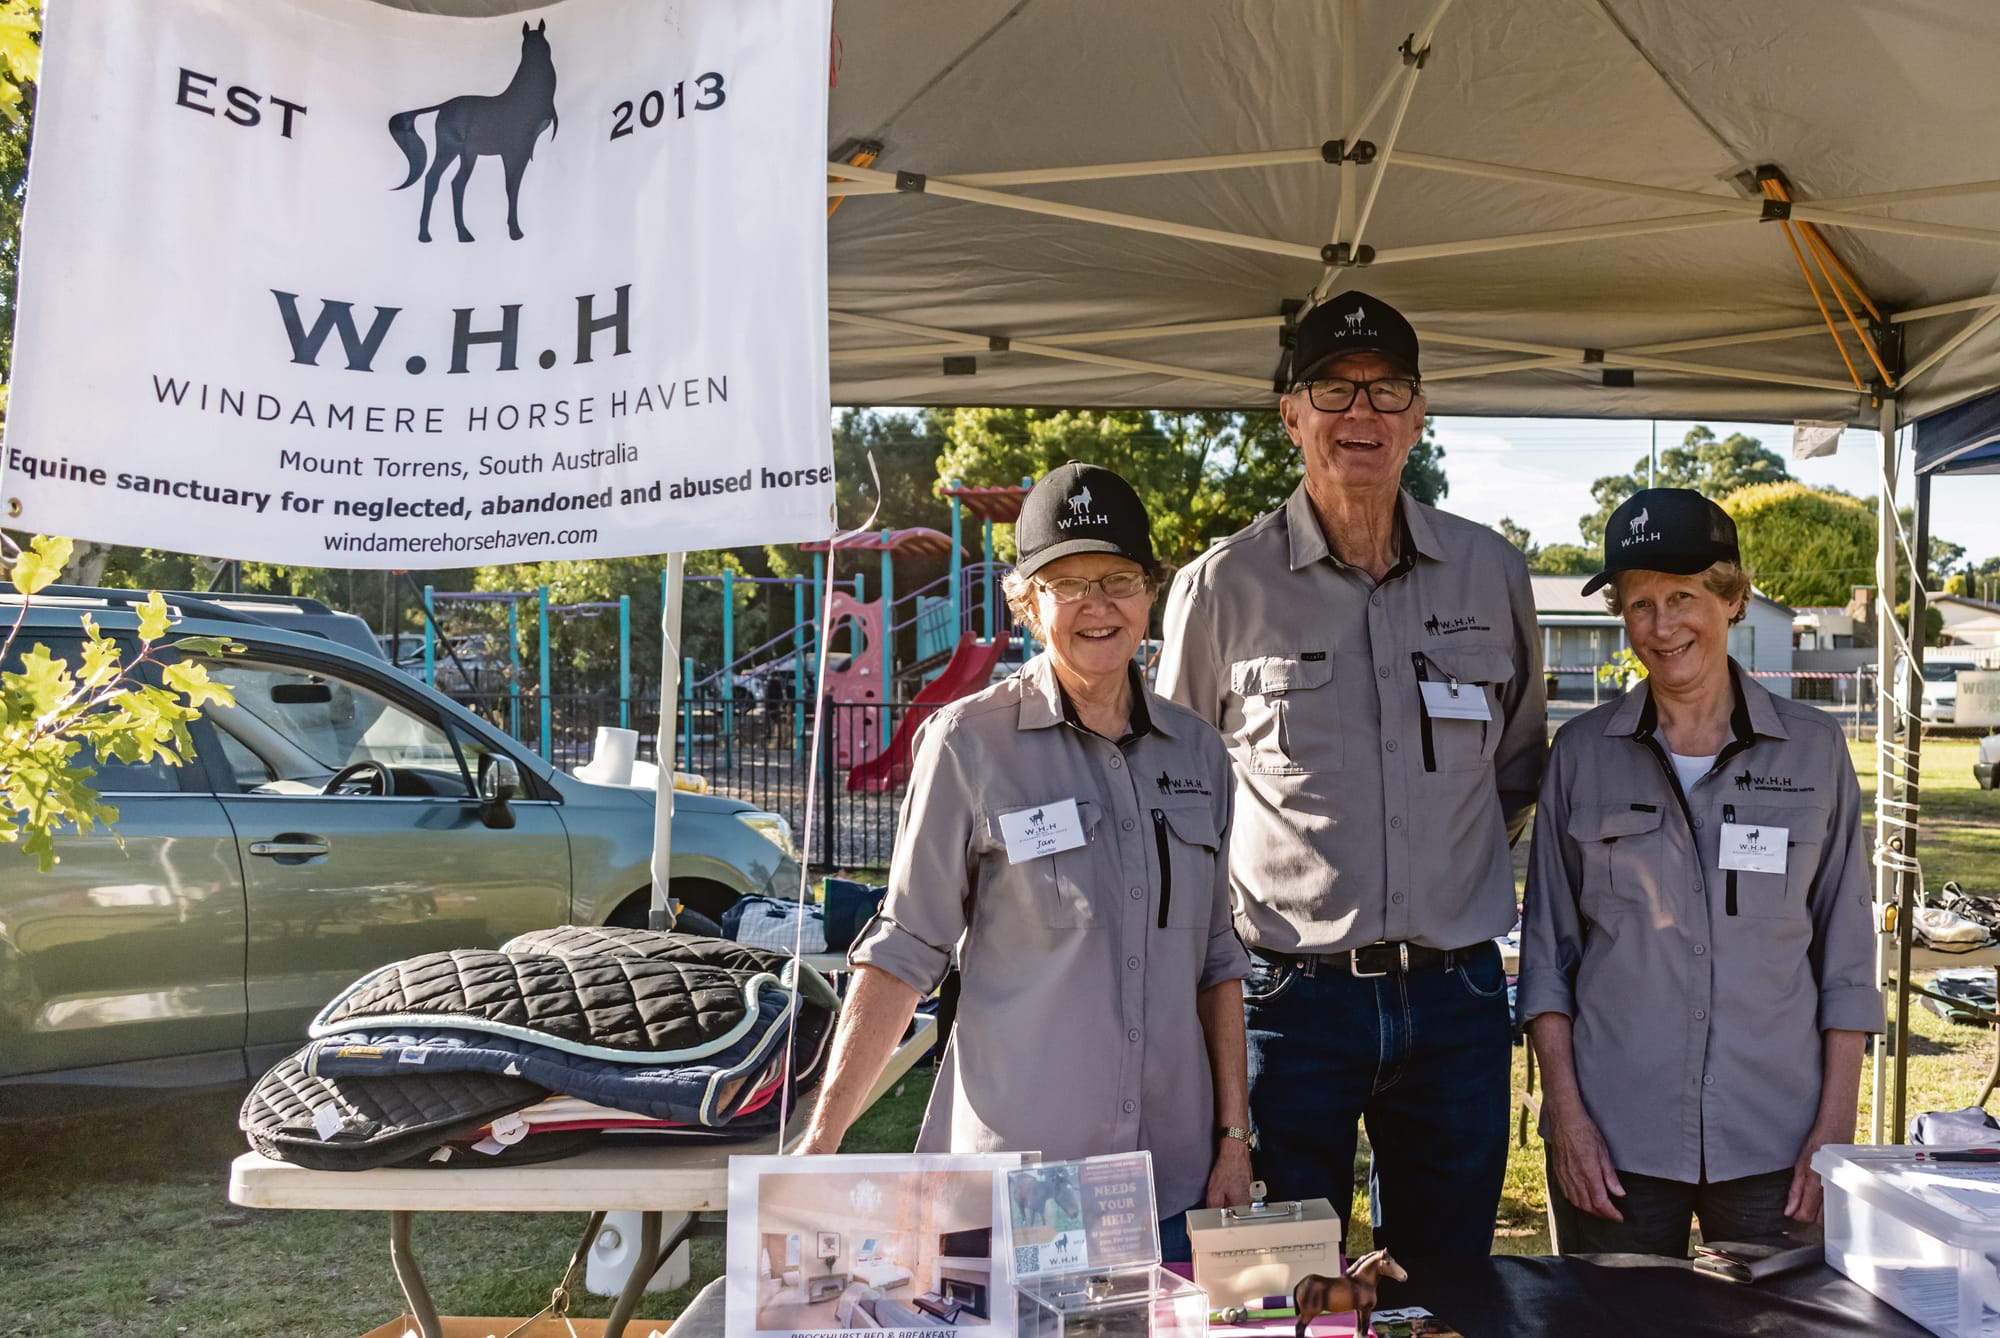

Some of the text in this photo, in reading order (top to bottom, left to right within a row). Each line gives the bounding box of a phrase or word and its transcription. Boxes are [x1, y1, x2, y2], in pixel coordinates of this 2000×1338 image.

[175, 66, 307, 139] EST
[609, 71, 726, 142] 2013
[269, 284, 633, 375] W.H.H
[153, 375, 728, 433] WINDAMERE HORSE HAVEN
[279, 443, 638, 479] Mount Torrens, South Australia
[116, 471, 271, 514] sanctuary
[281, 490, 324, 514] for
[334, 494, 472, 522] neglected,
[481, 486, 612, 516] abandoned
[620, 480, 662, 506] and
[669, 468, 752, 499] abused
[1057, 514, 1109, 530] W.H.H
[324, 526, 599, 553] windamerehorsehaven.com
[1621, 531, 1661, 548] W.H.H
[1440, 616, 1476, 629] W.H.H
[1035, 838, 1056, 850] Jan
[1094, 1182, 1137, 1197] NEEDS
[1098, 1198, 1135, 1212] YOUR
[1102, 1213, 1135, 1227] HELP
